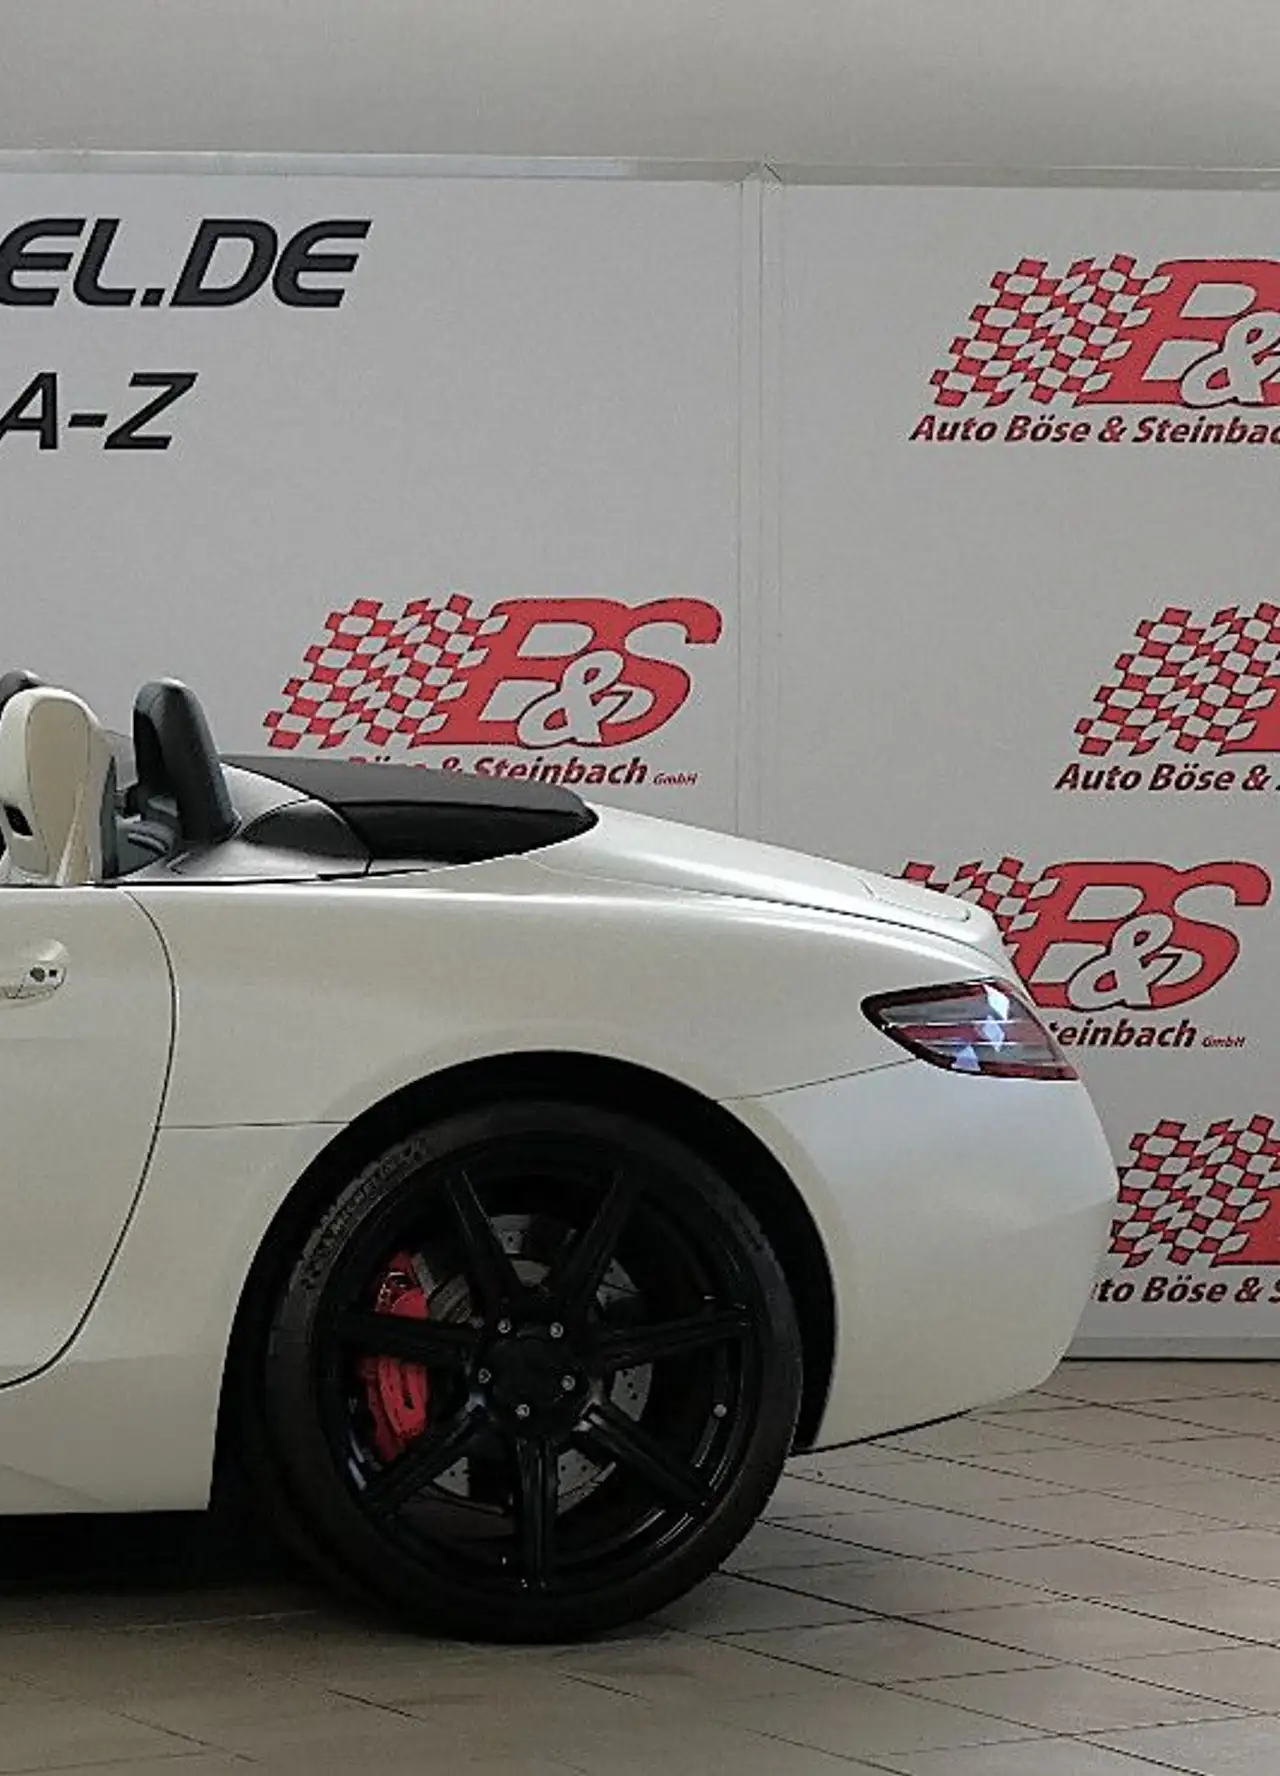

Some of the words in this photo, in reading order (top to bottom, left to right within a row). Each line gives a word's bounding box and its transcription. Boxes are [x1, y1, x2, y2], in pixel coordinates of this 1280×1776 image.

[1072, 257, 1280, 411] B&
[908, 413, 998, 443] Auto
[1003, 413, 1092, 444] Böse
[1097, 415, 1128, 444] &
[413, 594, 725, 750] B&S
[474, 756, 648, 785] Steinbach
[653, 772, 698, 786] GmbH
[1053, 762, 1143, 792] Auto
[1148, 762, 1236, 793] Böse
[1241, 763, 1272, 793] &
[1050, 1019, 1198, 1049] einbach
[1200, 1035, 1246, 1049] GmbH
[1140, 1274, 1229, 1305] Böse
[1234, 1276, 1265, 1305] &
